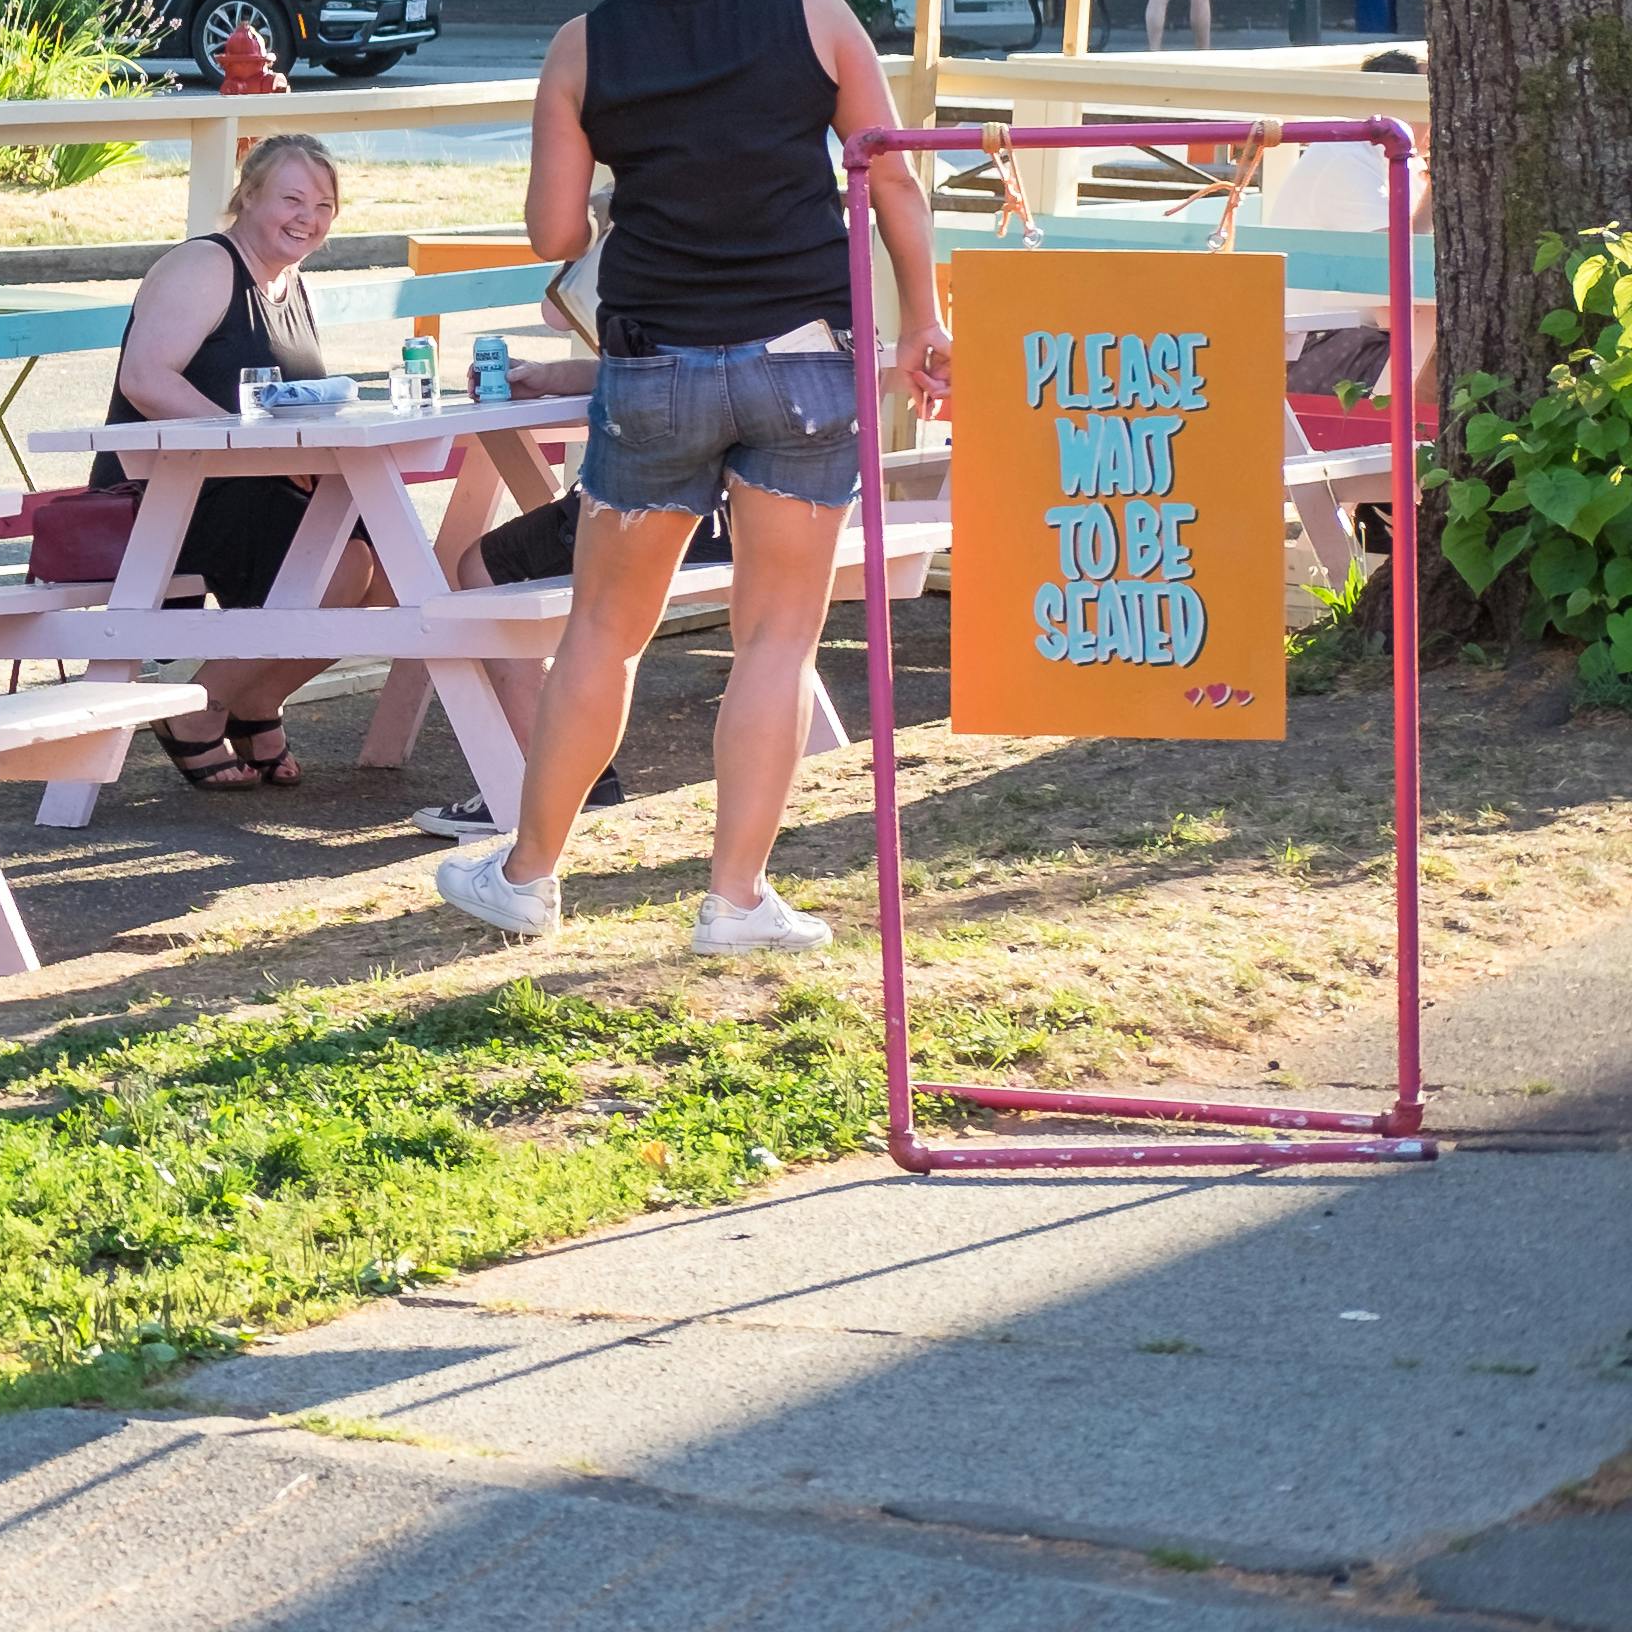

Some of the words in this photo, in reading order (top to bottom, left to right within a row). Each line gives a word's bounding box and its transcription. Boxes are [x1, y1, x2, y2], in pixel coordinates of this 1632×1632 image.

[1022, 331, 1209, 411] PLEASE
[1054, 415, 1184, 497] WAIT
[1045, 504, 1118, 580] TO
[1125, 502, 1199, 581] BE
[1033, 582, 1209, 668] SEATED
